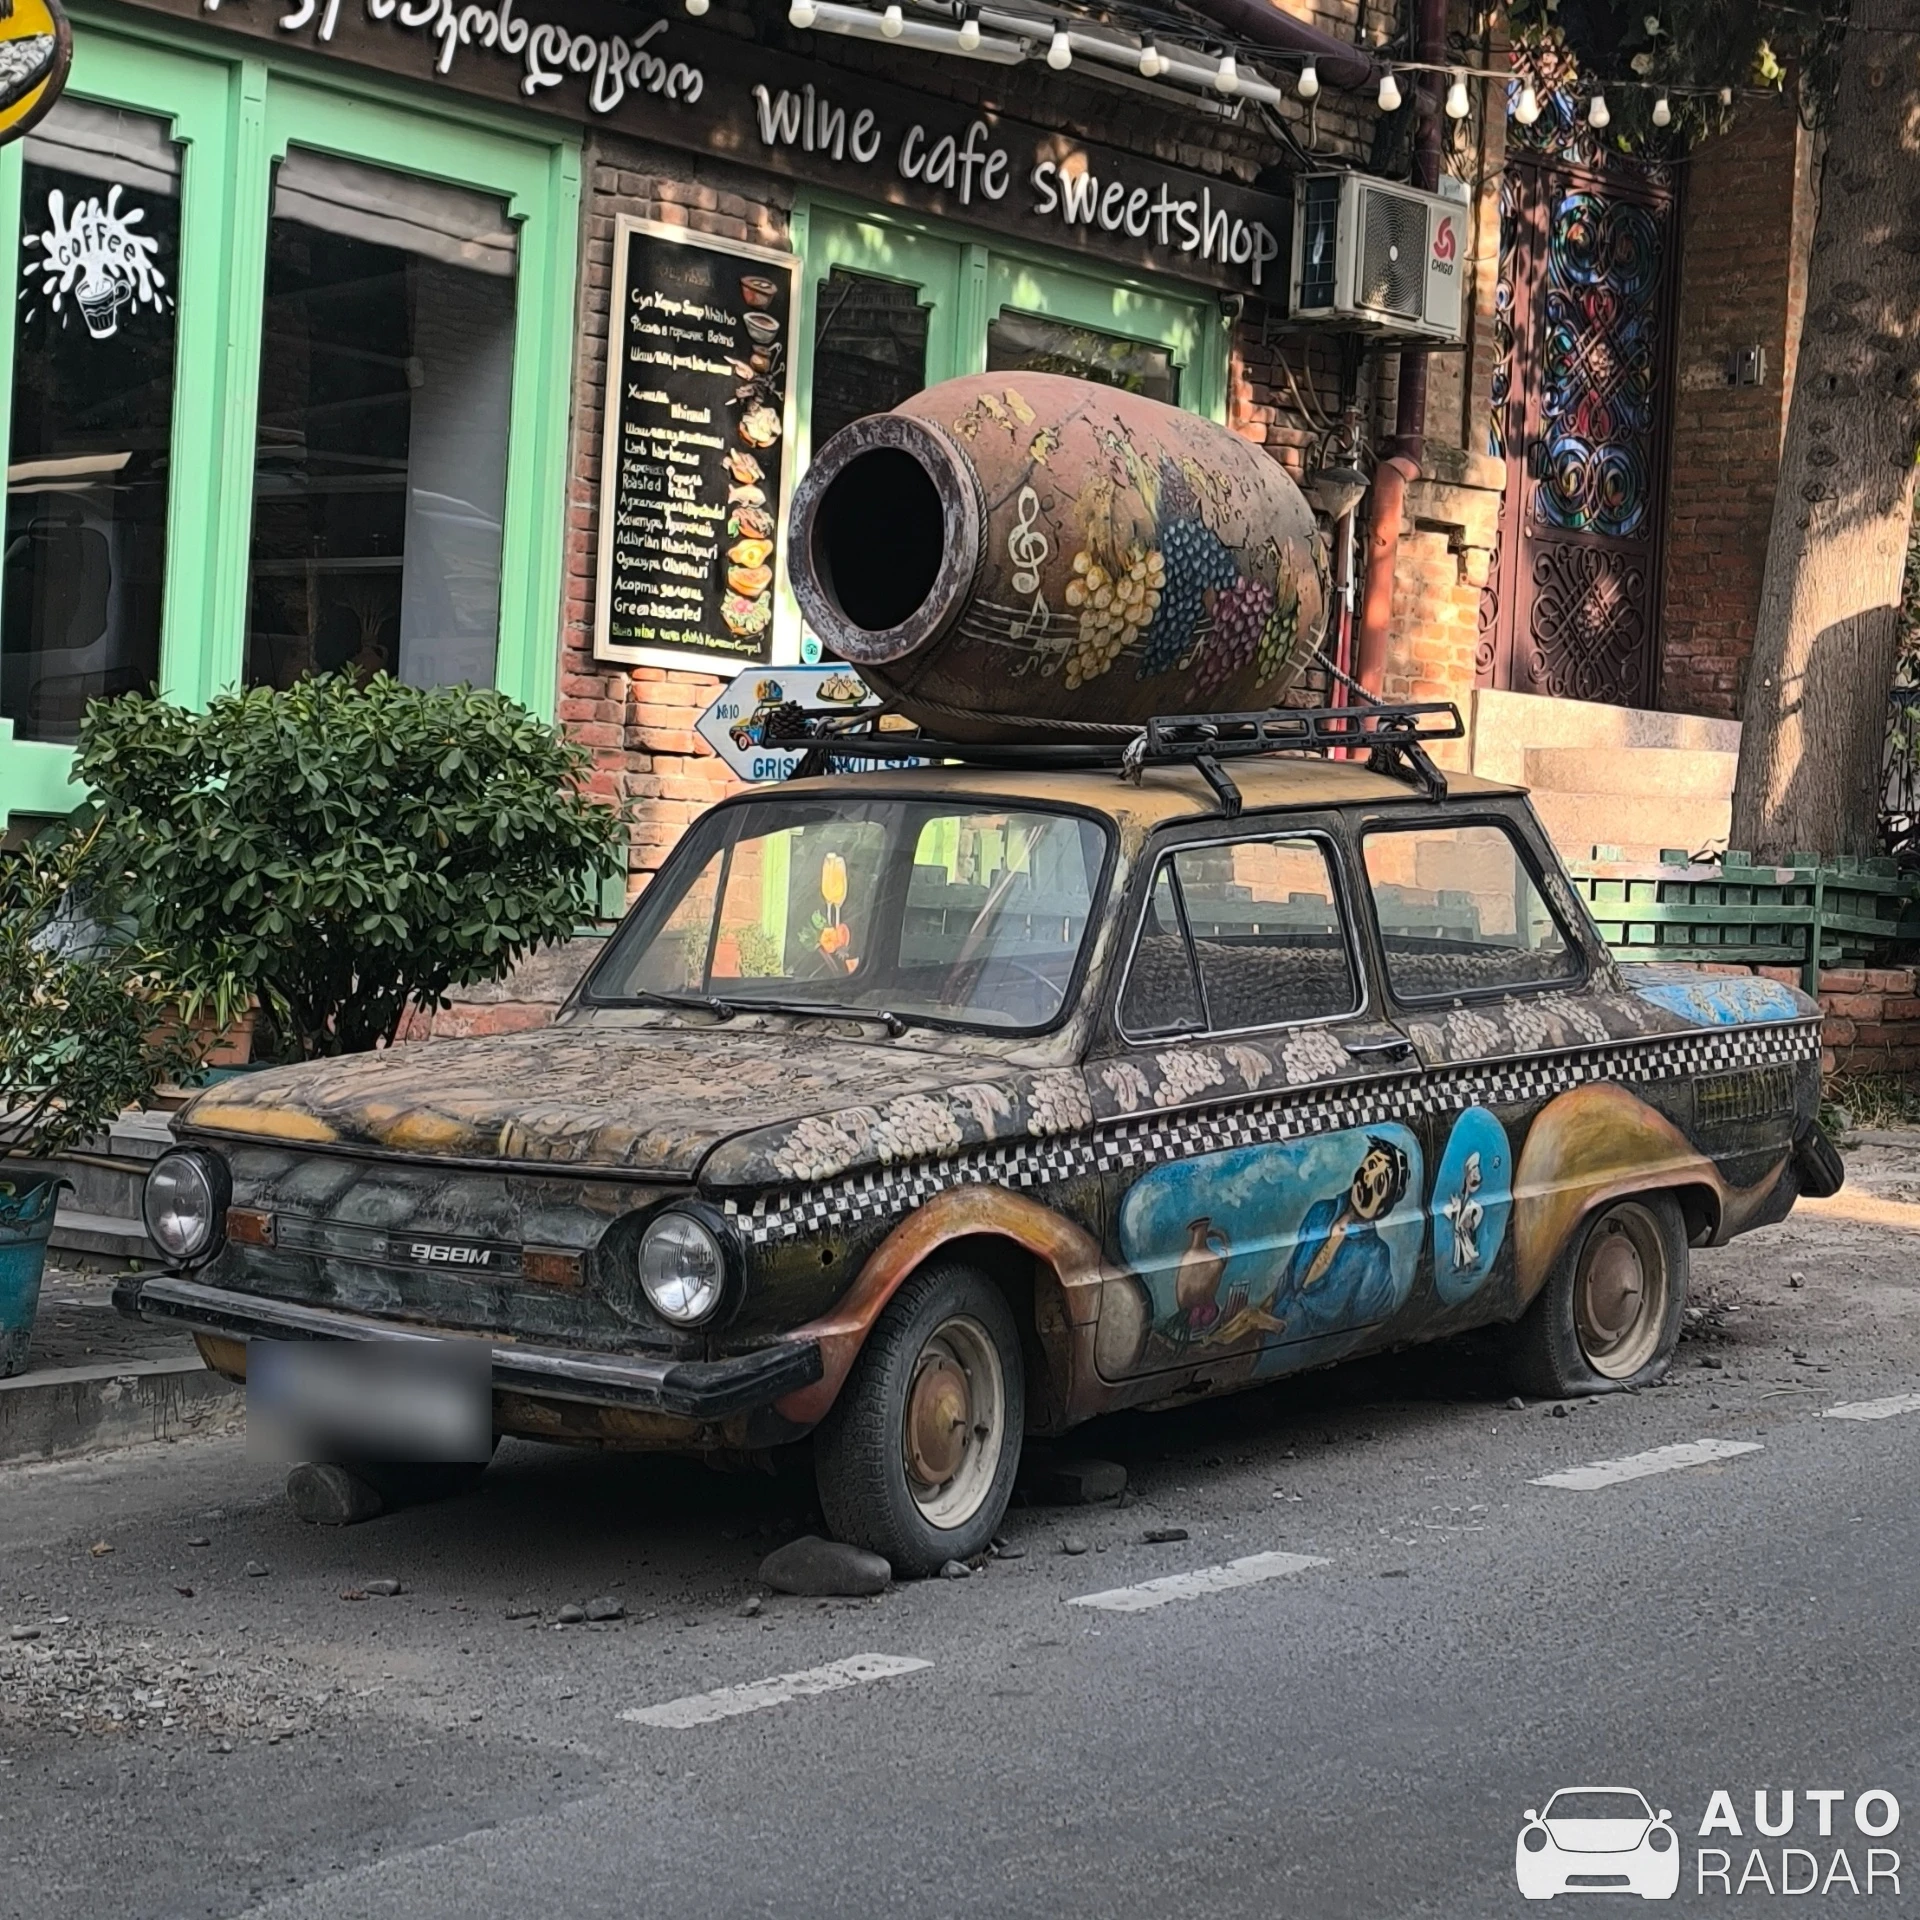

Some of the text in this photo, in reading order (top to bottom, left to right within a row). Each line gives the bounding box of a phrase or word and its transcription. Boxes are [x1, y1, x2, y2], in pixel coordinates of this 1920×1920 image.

[753, 83, 1279, 286] wine cafe sweetshop
[1431, 258, 1454, 276] CHIGO
[708, 330, 734, 347] Beans
[623, 473, 661, 491] Roasted
[410, 1243, 490, 1265] 968M
